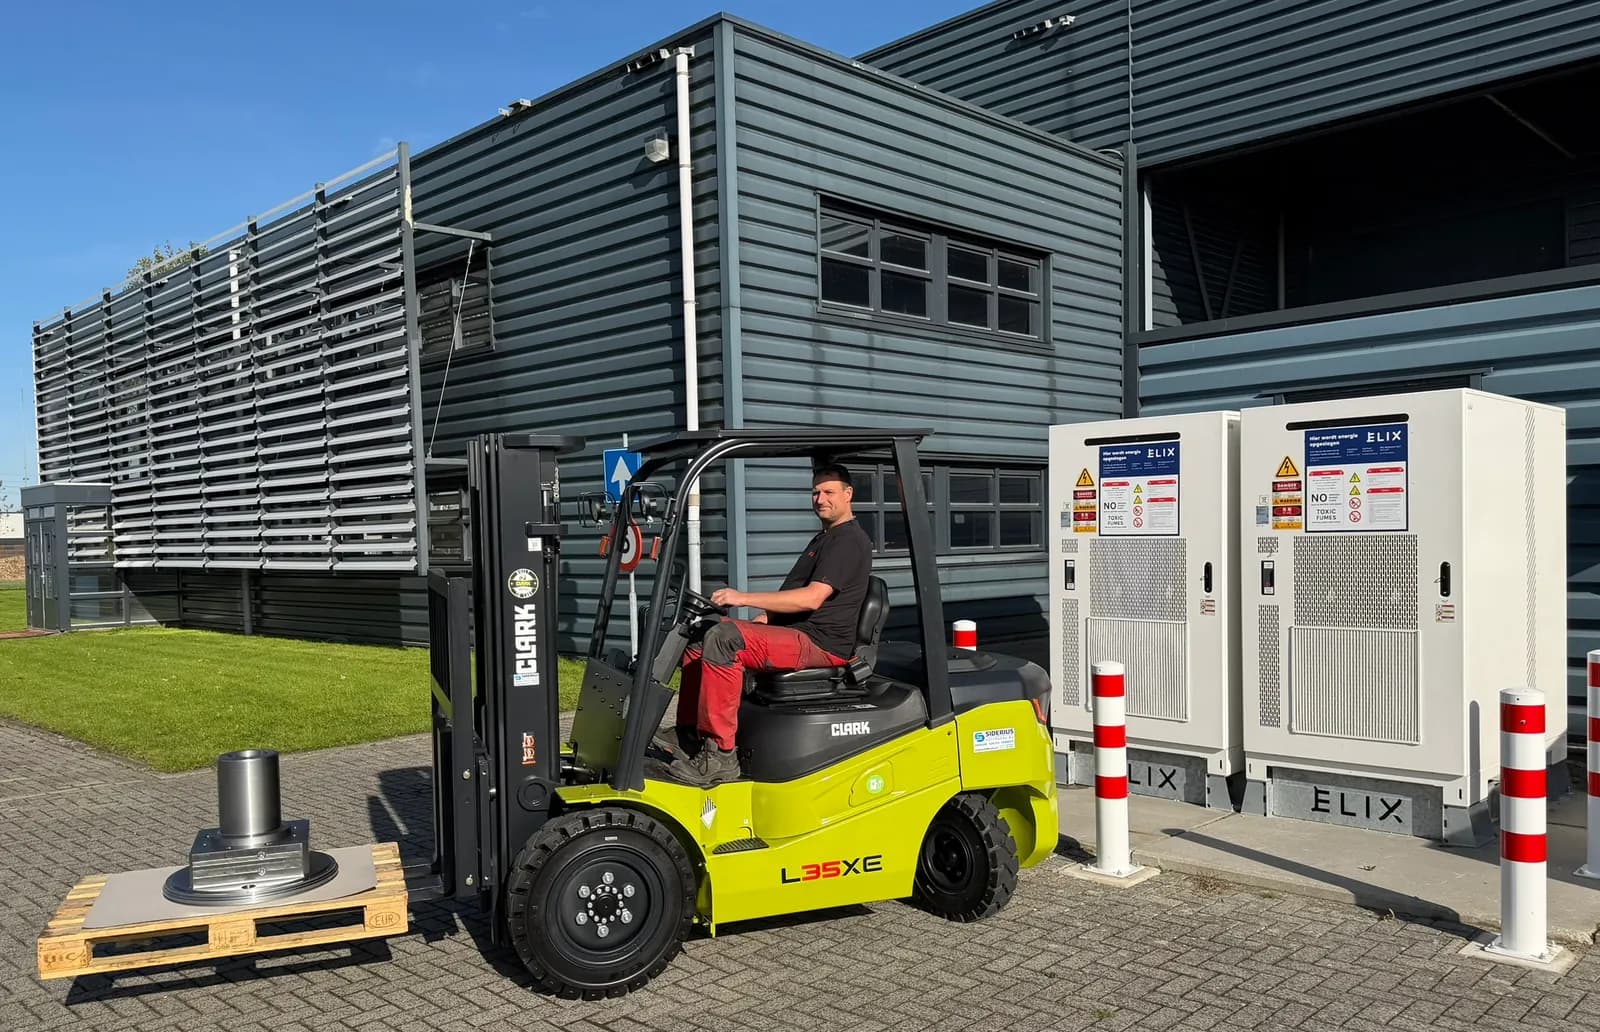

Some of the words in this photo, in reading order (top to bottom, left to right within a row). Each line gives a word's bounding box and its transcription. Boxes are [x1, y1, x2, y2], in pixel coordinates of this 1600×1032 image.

[1366, 430, 1402, 443] ELIX
[1147, 447, 1175, 458] ELIX
[1311, 493, 1328, 503] NO
[1103, 502, 1117, 510] NO
[514, 604, 538, 674] CLARK
[831, 721, 870, 737] CLARK
[985, 729, 1014, 737] SIDERIUS
[1128, 763, 1177, 791] LIX
[1311, 786, 1403, 823] ELIX
[781, 855, 882, 884] L35XE
[375, 914, 394, 926] EUR
